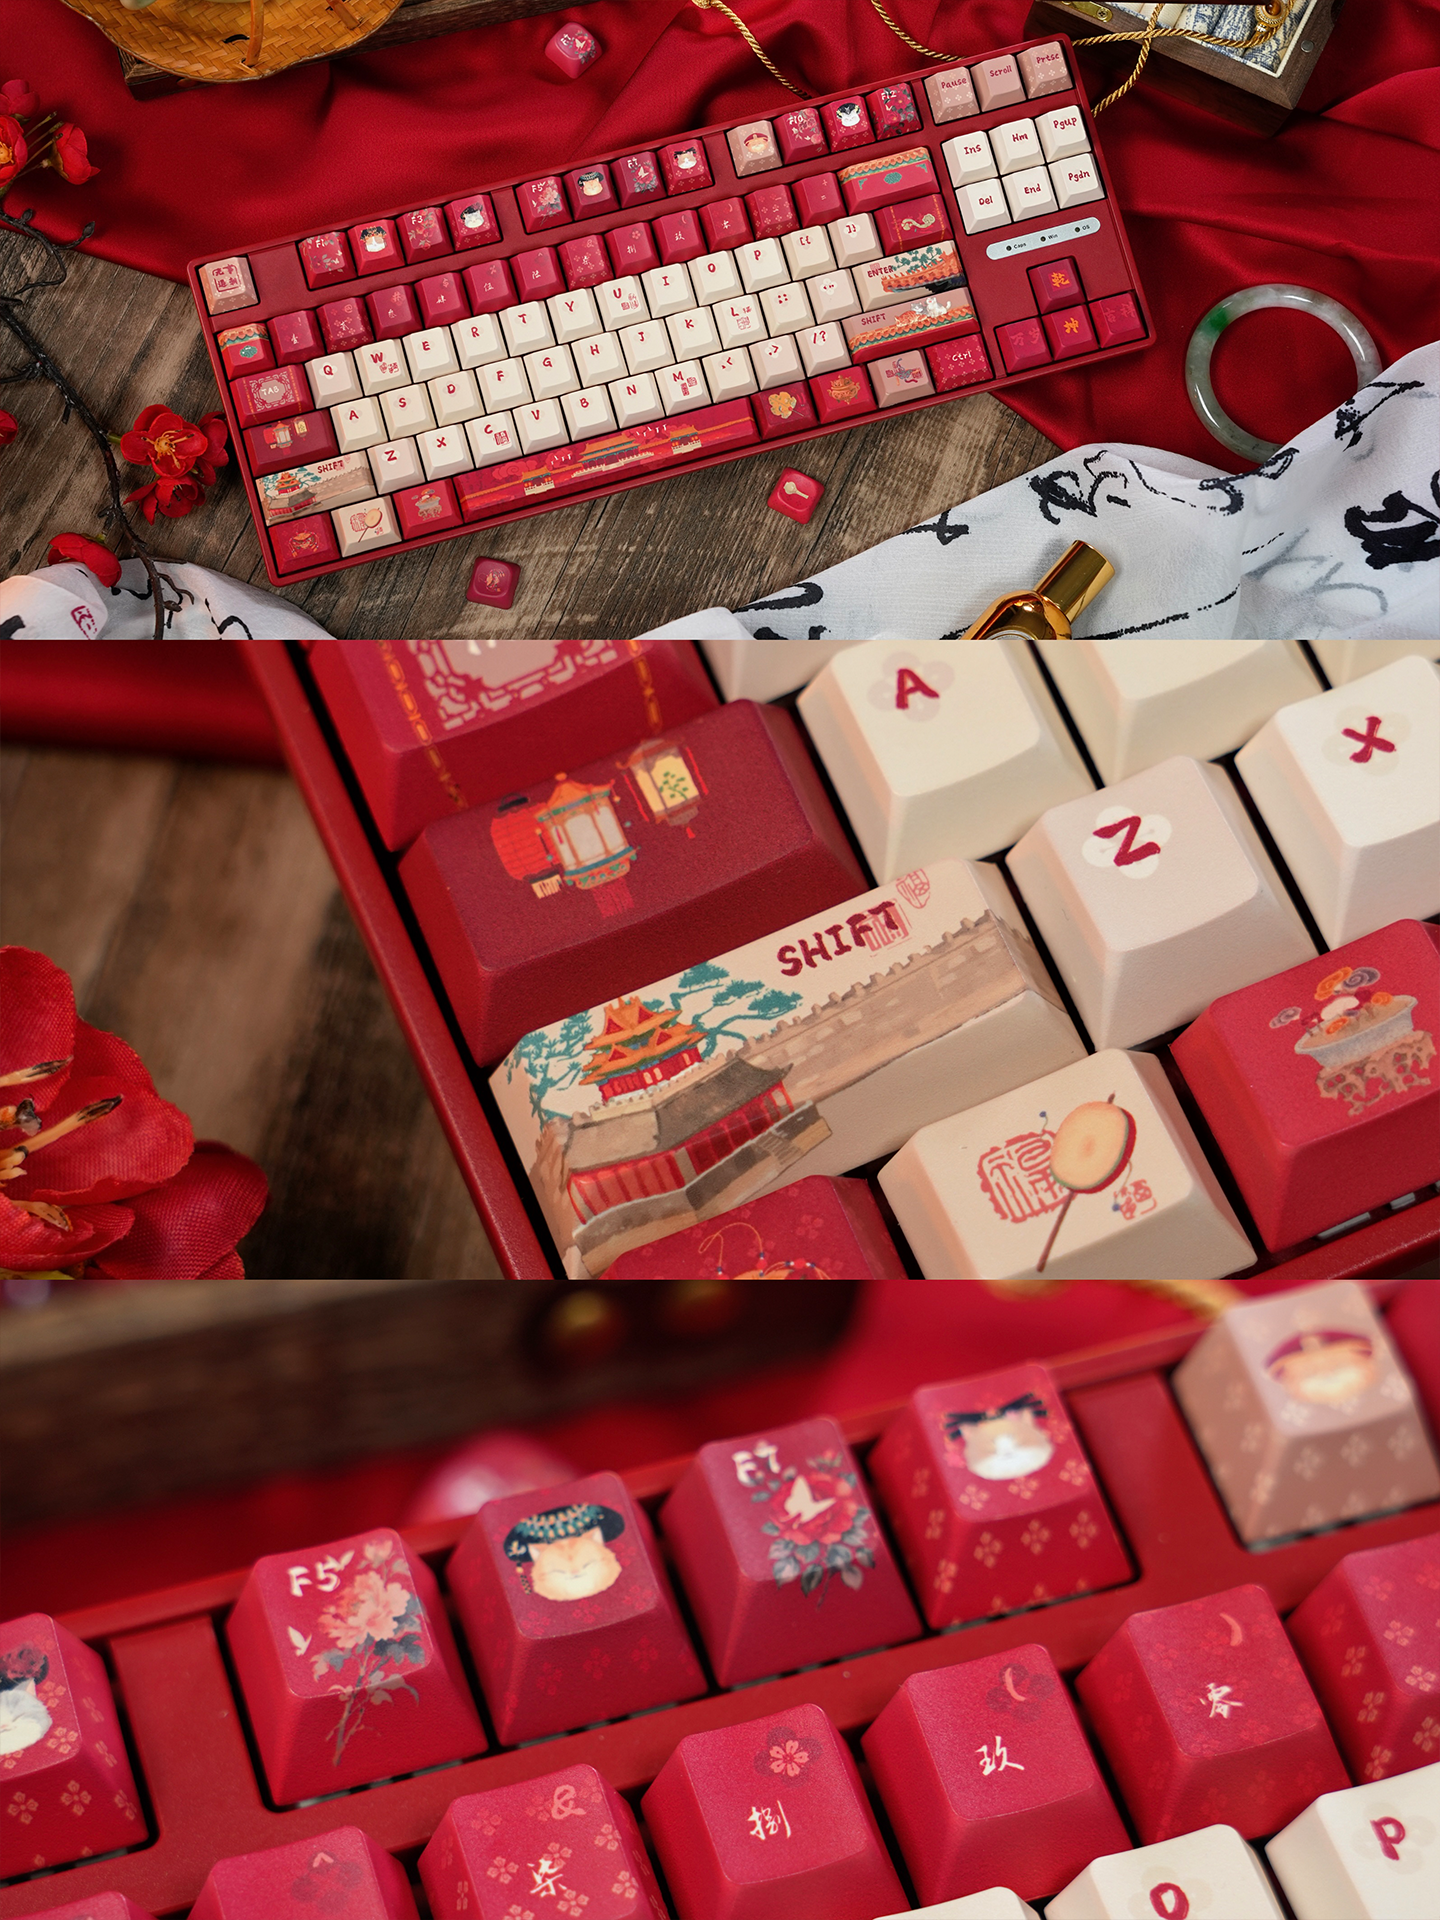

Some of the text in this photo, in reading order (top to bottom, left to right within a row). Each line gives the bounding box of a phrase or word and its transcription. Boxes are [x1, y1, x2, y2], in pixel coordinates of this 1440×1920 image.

[1036, 54, 1059, 63] Prtsc
[989, 65, 1012, 77] Scroll
[941, 78, 967, 88] Pause
[881, 90, 896, 100] F12
[1013, 134, 1028, 142] Hm
[964, 145, 981, 154] Ins
[1068, 171, 1090, 182] Pgdn
[532, 184, 543, 193] F5
[1024, 184, 1041, 194] End
[979, 196, 993, 205] Del
[412, 214, 422, 224] F3
[1013, 242, 1027, 250] Caps
[754, 250, 761, 260] P
[867, 265, 894, 278] ENTER
[662, 276, 669, 286] I
[613, 288, 621, 298] U
[565, 301, 574, 312] Y
[731, 307, 739, 316] L
[518, 314, 526, 323] T
[861, 313, 886, 326] SHIFT
[685, 320, 694, 328] K
[471, 327, 479, 337] R
[638, 332, 644, 341] J
[422, 341, 430, 351] E
[590, 344, 599, 355] H
[371, 352, 383, 364] W
[952, 351, 972, 361] Ctrl
[543, 357, 552, 367] G
[324, 365, 333, 375] Q
[497, 371, 504, 381] F
[673, 371, 684, 382] M
[261, 386, 280, 396] TAB
[447, 384, 455, 394] D
[627, 385, 636, 395] N
[399, 398, 406, 407] S
[580, 398, 589, 408] B
[350, 410, 359, 420] A
[531, 410, 539, 420] V
[484, 425, 493, 434] C
[437, 437, 446, 448] X
[385, 450, 397, 461] Z
[317, 459, 344, 474] SHIFT
[896, 668, 939, 709] A
[1342, 716, 1396, 763] X
[1093, 815, 1161, 866] Z
[777, 901, 899, 976] SHIFT
[289, 1564, 341, 1596] F5
[975, 1736, 1025, 1776] 玖
[550, 1784, 587, 1821] &
[748, 1801, 790, 1840] 捌
[1371, 1817, 1406, 1860] P
